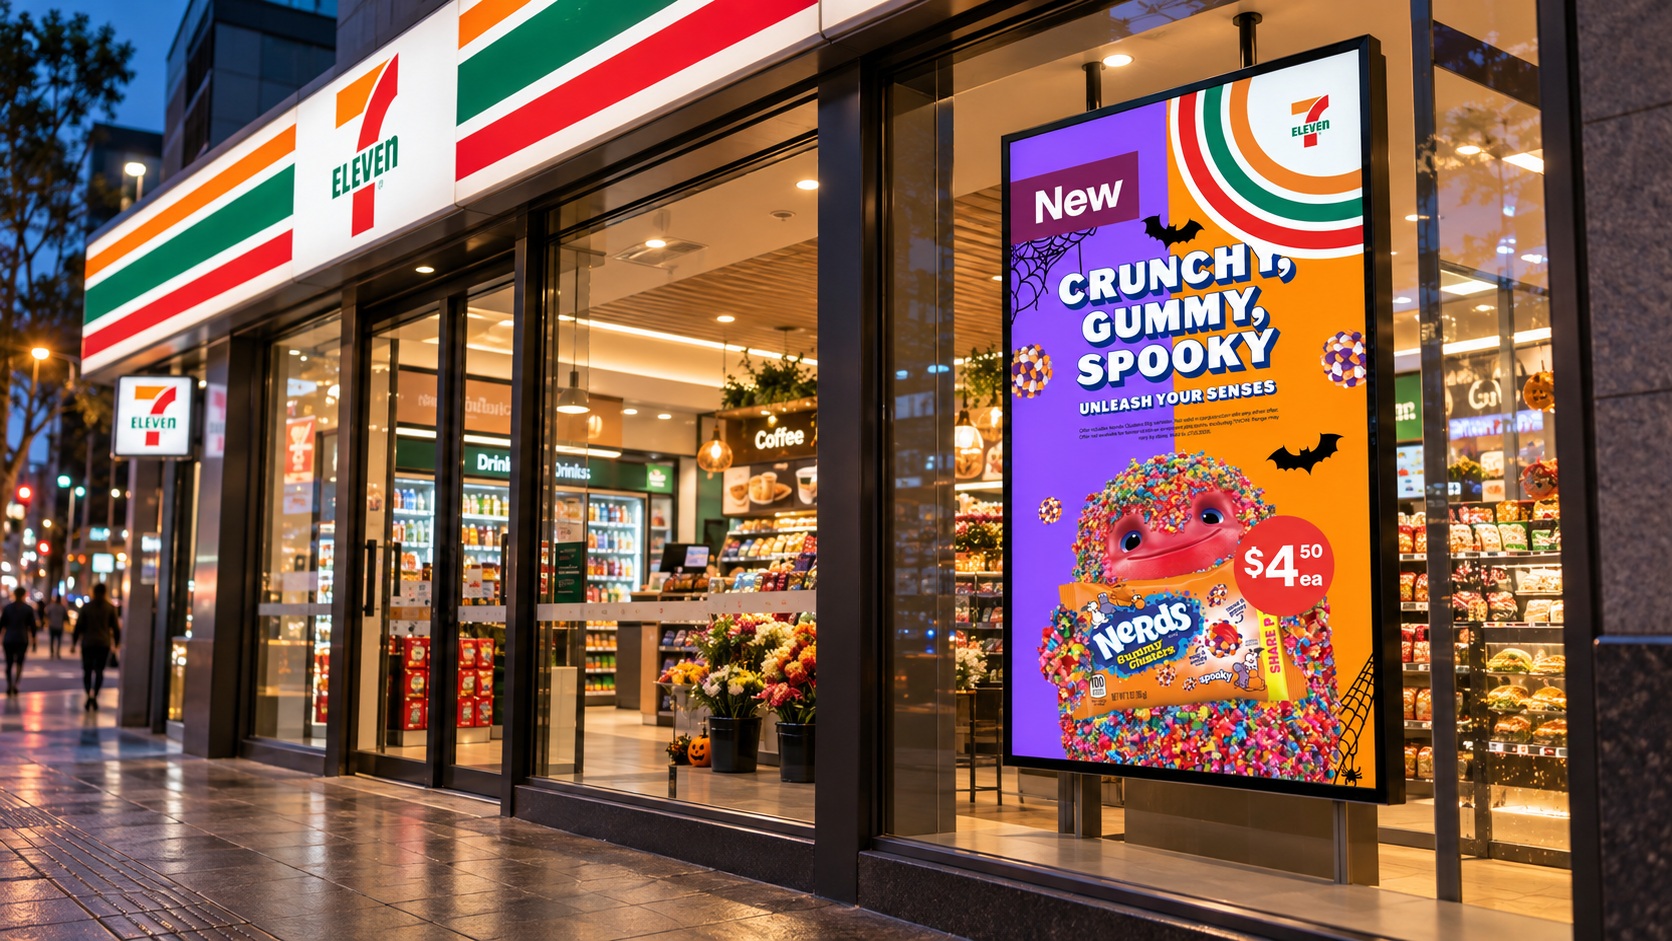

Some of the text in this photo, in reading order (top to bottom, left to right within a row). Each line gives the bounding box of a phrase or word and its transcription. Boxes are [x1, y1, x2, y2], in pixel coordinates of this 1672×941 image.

[335, 52, 399, 238] 7
[1291, 94, 1329, 148] 7
[1035, 179, 1124, 225] New
[1058, 242, 1296, 310] CRUNCHY,
[1082, 285, 1270, 348] GUMMY,
[1076, 327, 1281, 391] SPOOKY
[135, 385, 177, 447] 7
[1079, 379, 1278, 417] UNLEASH YOUR SENSES
[755, 426, 805, 450] Coffee
[1300, 574, 1323, 587] ea
[1265, 629, 1281, 674] SHARE
